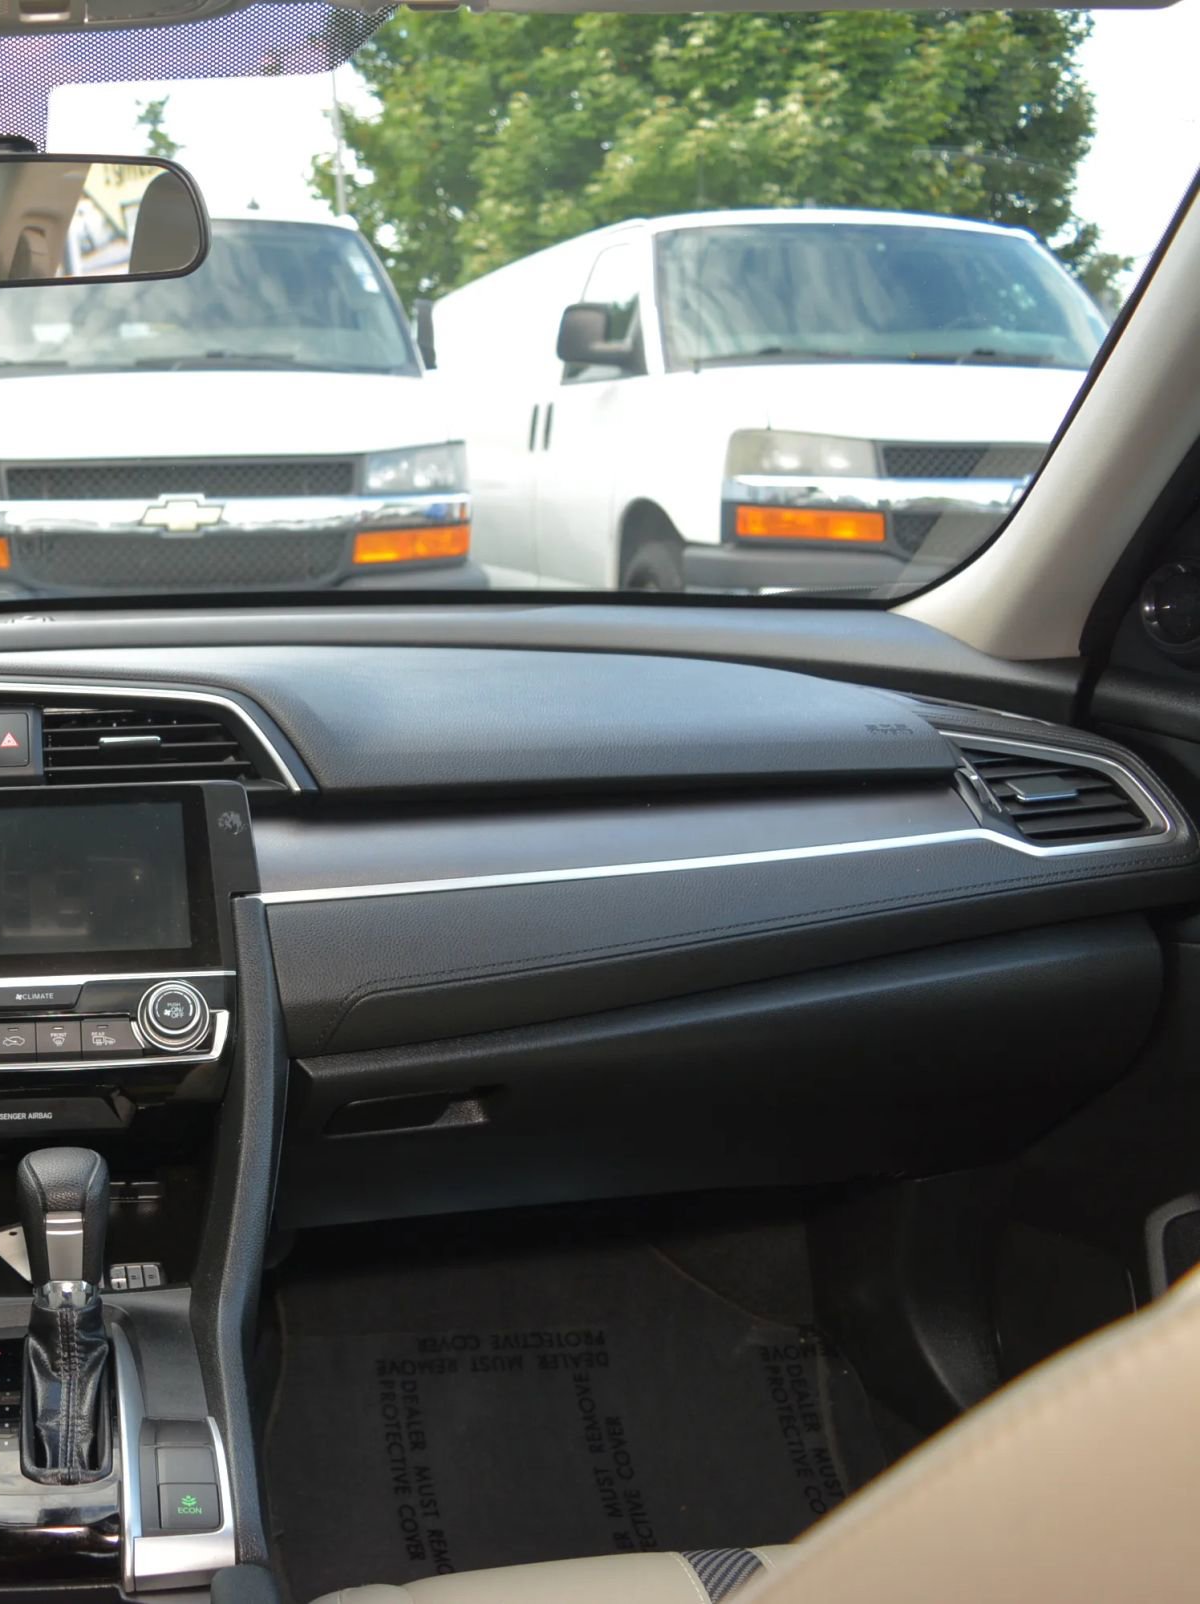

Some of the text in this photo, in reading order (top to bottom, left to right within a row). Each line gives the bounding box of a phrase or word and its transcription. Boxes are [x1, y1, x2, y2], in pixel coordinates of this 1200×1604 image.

[22, 992, 54, 1000] CLIMATE
[28, 1111, 53, 1120] AIRBAG
[375, 1351, 609, 1377] DEALER MUST REMOVE
[417, 1330, 606, 1353] PROTECTIVE COVER
[400, 1379, 427, 1452] DEALER
[573, 1371, 624, 1518] MUST REMOVE
[764, 1364, 814, 1478] PROTECTIVE
[784, 1363, 822, 1433] DEALER
[813, 1447, 846, 1500] MUST
[378, 1379, 427, 1561] PROTECTIVE COVER
[605, 1416, 635, 1480] COVER
[177, 1506, 203, 1515] ECON
[413, 1465, 440, 1519] MUST
